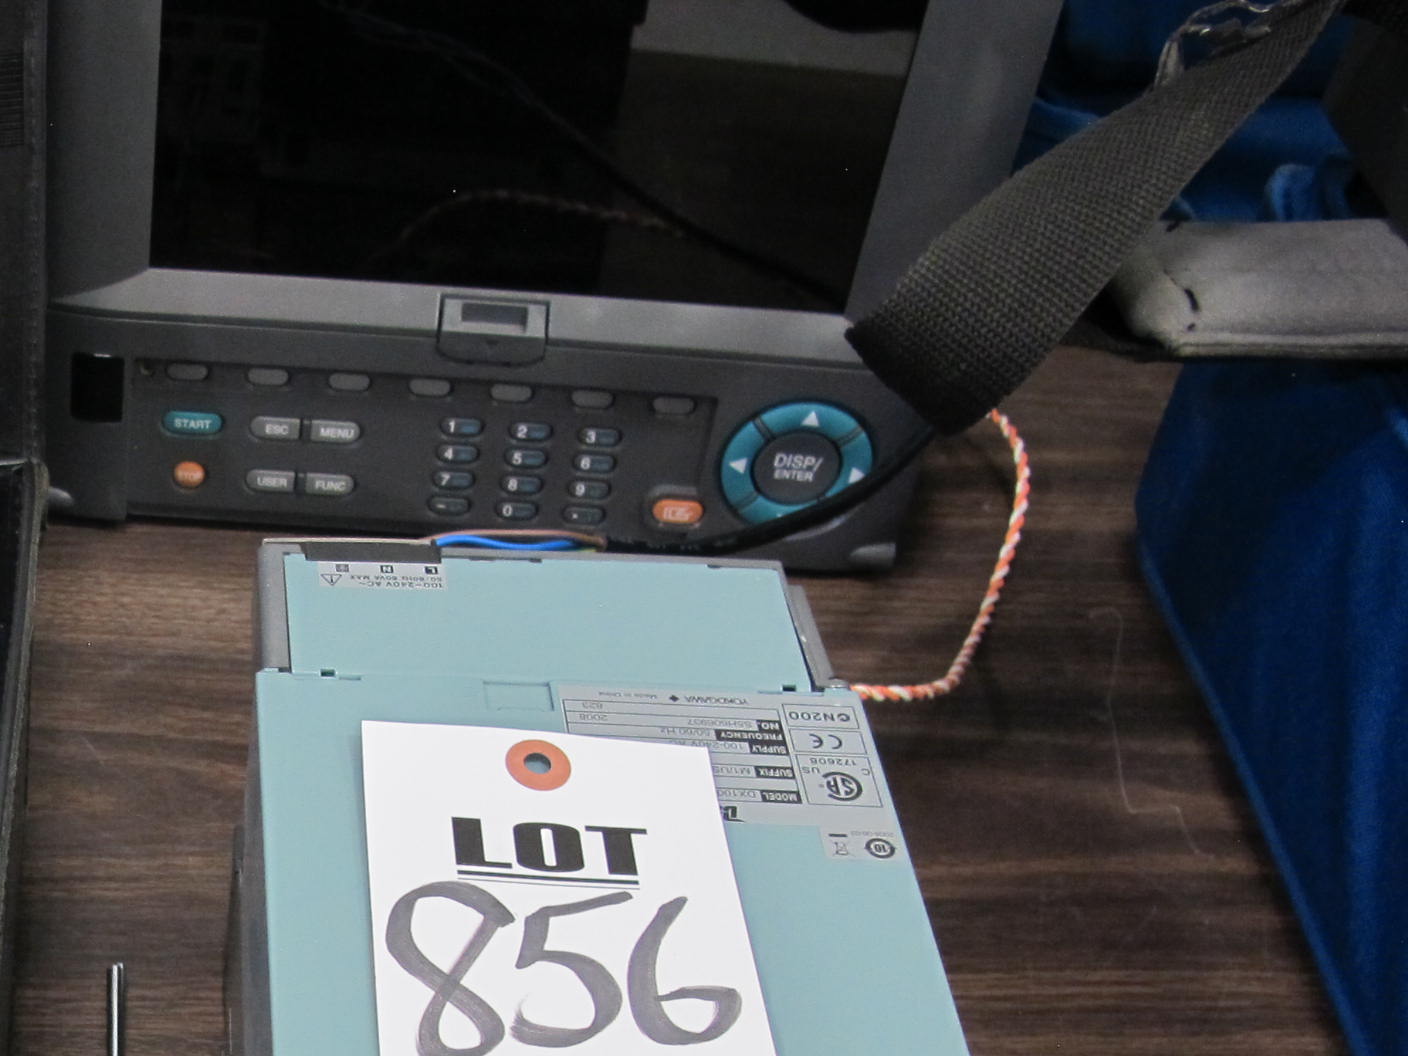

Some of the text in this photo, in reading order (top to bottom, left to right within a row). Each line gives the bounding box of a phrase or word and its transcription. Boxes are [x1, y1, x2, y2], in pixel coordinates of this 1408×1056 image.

[175, 419, 212, 430] START
[265, 424, 288, 435] ESC
[320, 427, 354, 438] MENU
[773, 452, 824, 471] DISP/
[773, 469, 813, 482] ENTER
[257, 477, 288, 488] USER
[315, 480, 346, 491] FUNC
[718, 730, 783, 741] FREQUENCY
[751, 743, 787, 755] SUPPLY
[758, 767, 794, 778] SUFFIX
[762, 791, 798, 802] MODEL
[451, 816, 647, 876] LOT
